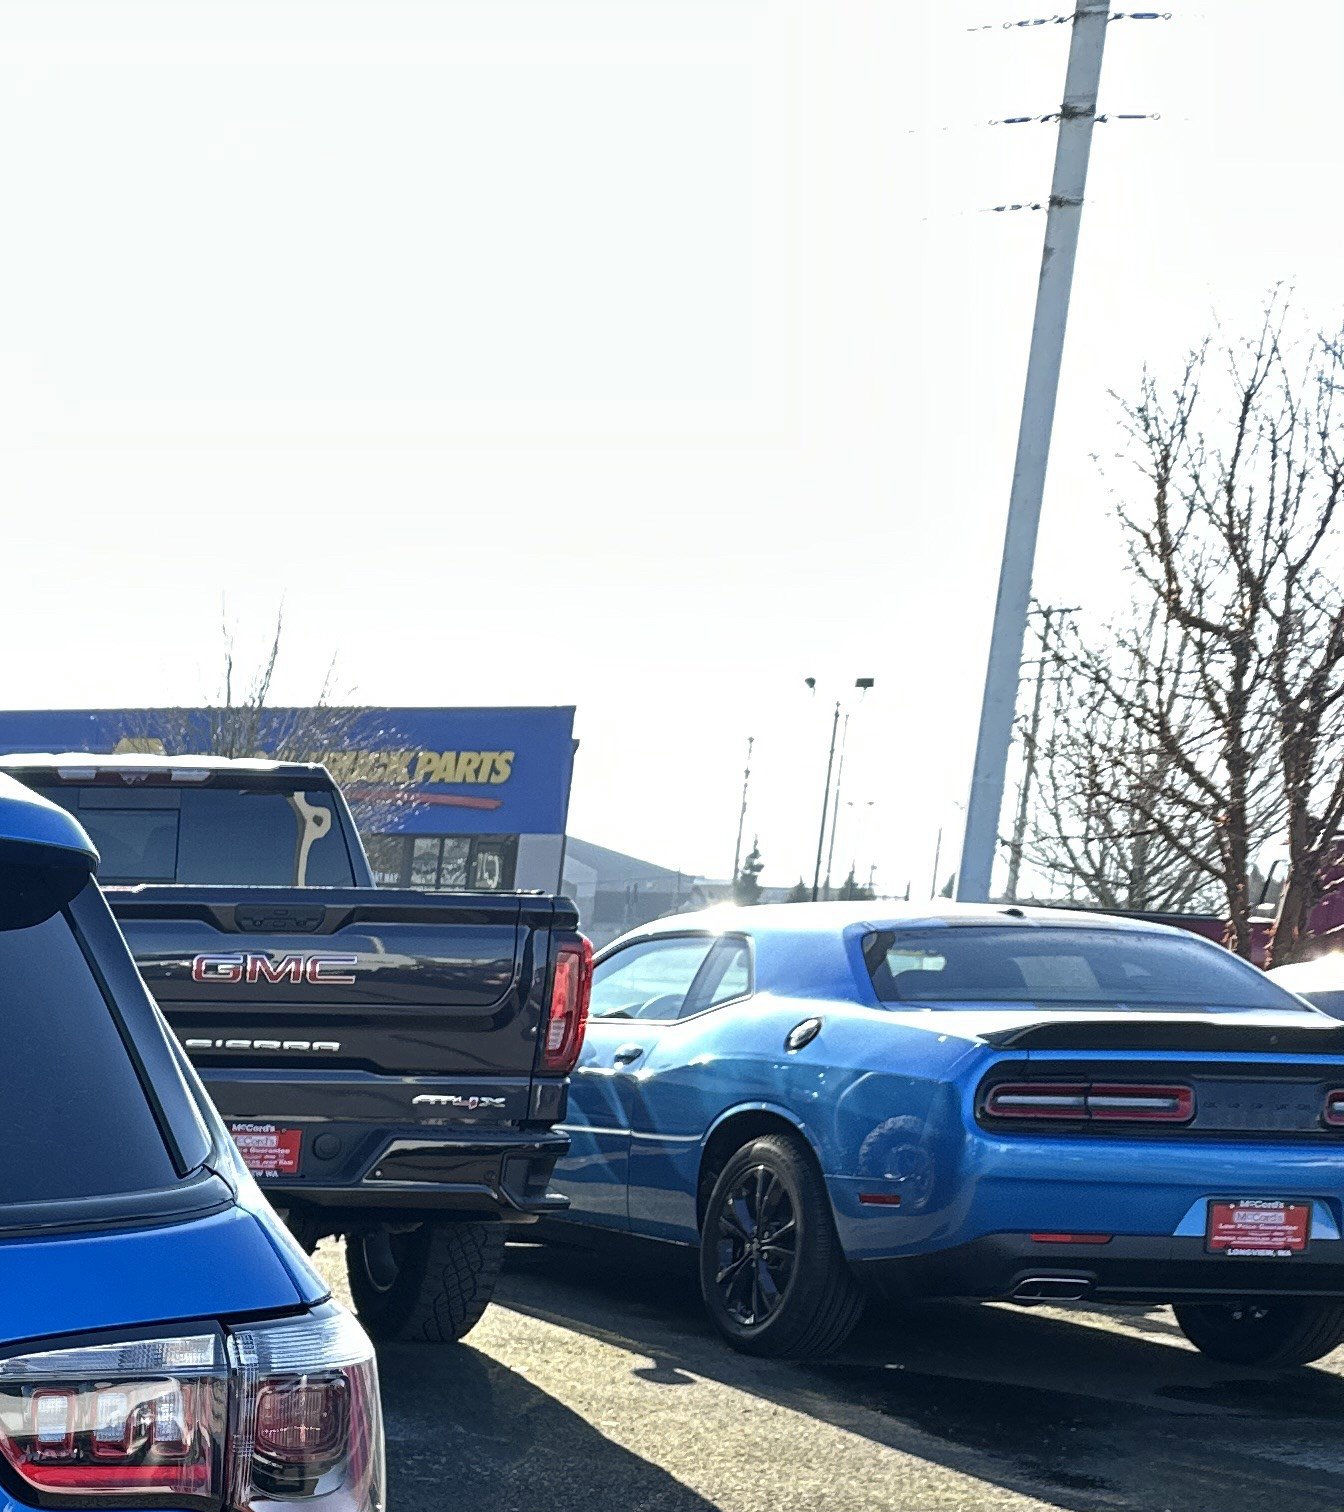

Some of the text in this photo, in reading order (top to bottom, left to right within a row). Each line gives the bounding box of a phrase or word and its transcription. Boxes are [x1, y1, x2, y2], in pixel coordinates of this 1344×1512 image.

[413, 751, 515, 785] PARTS
[192, 953, 358, 985] GMC
[185, 1038, 342, 1052] SIERRA
